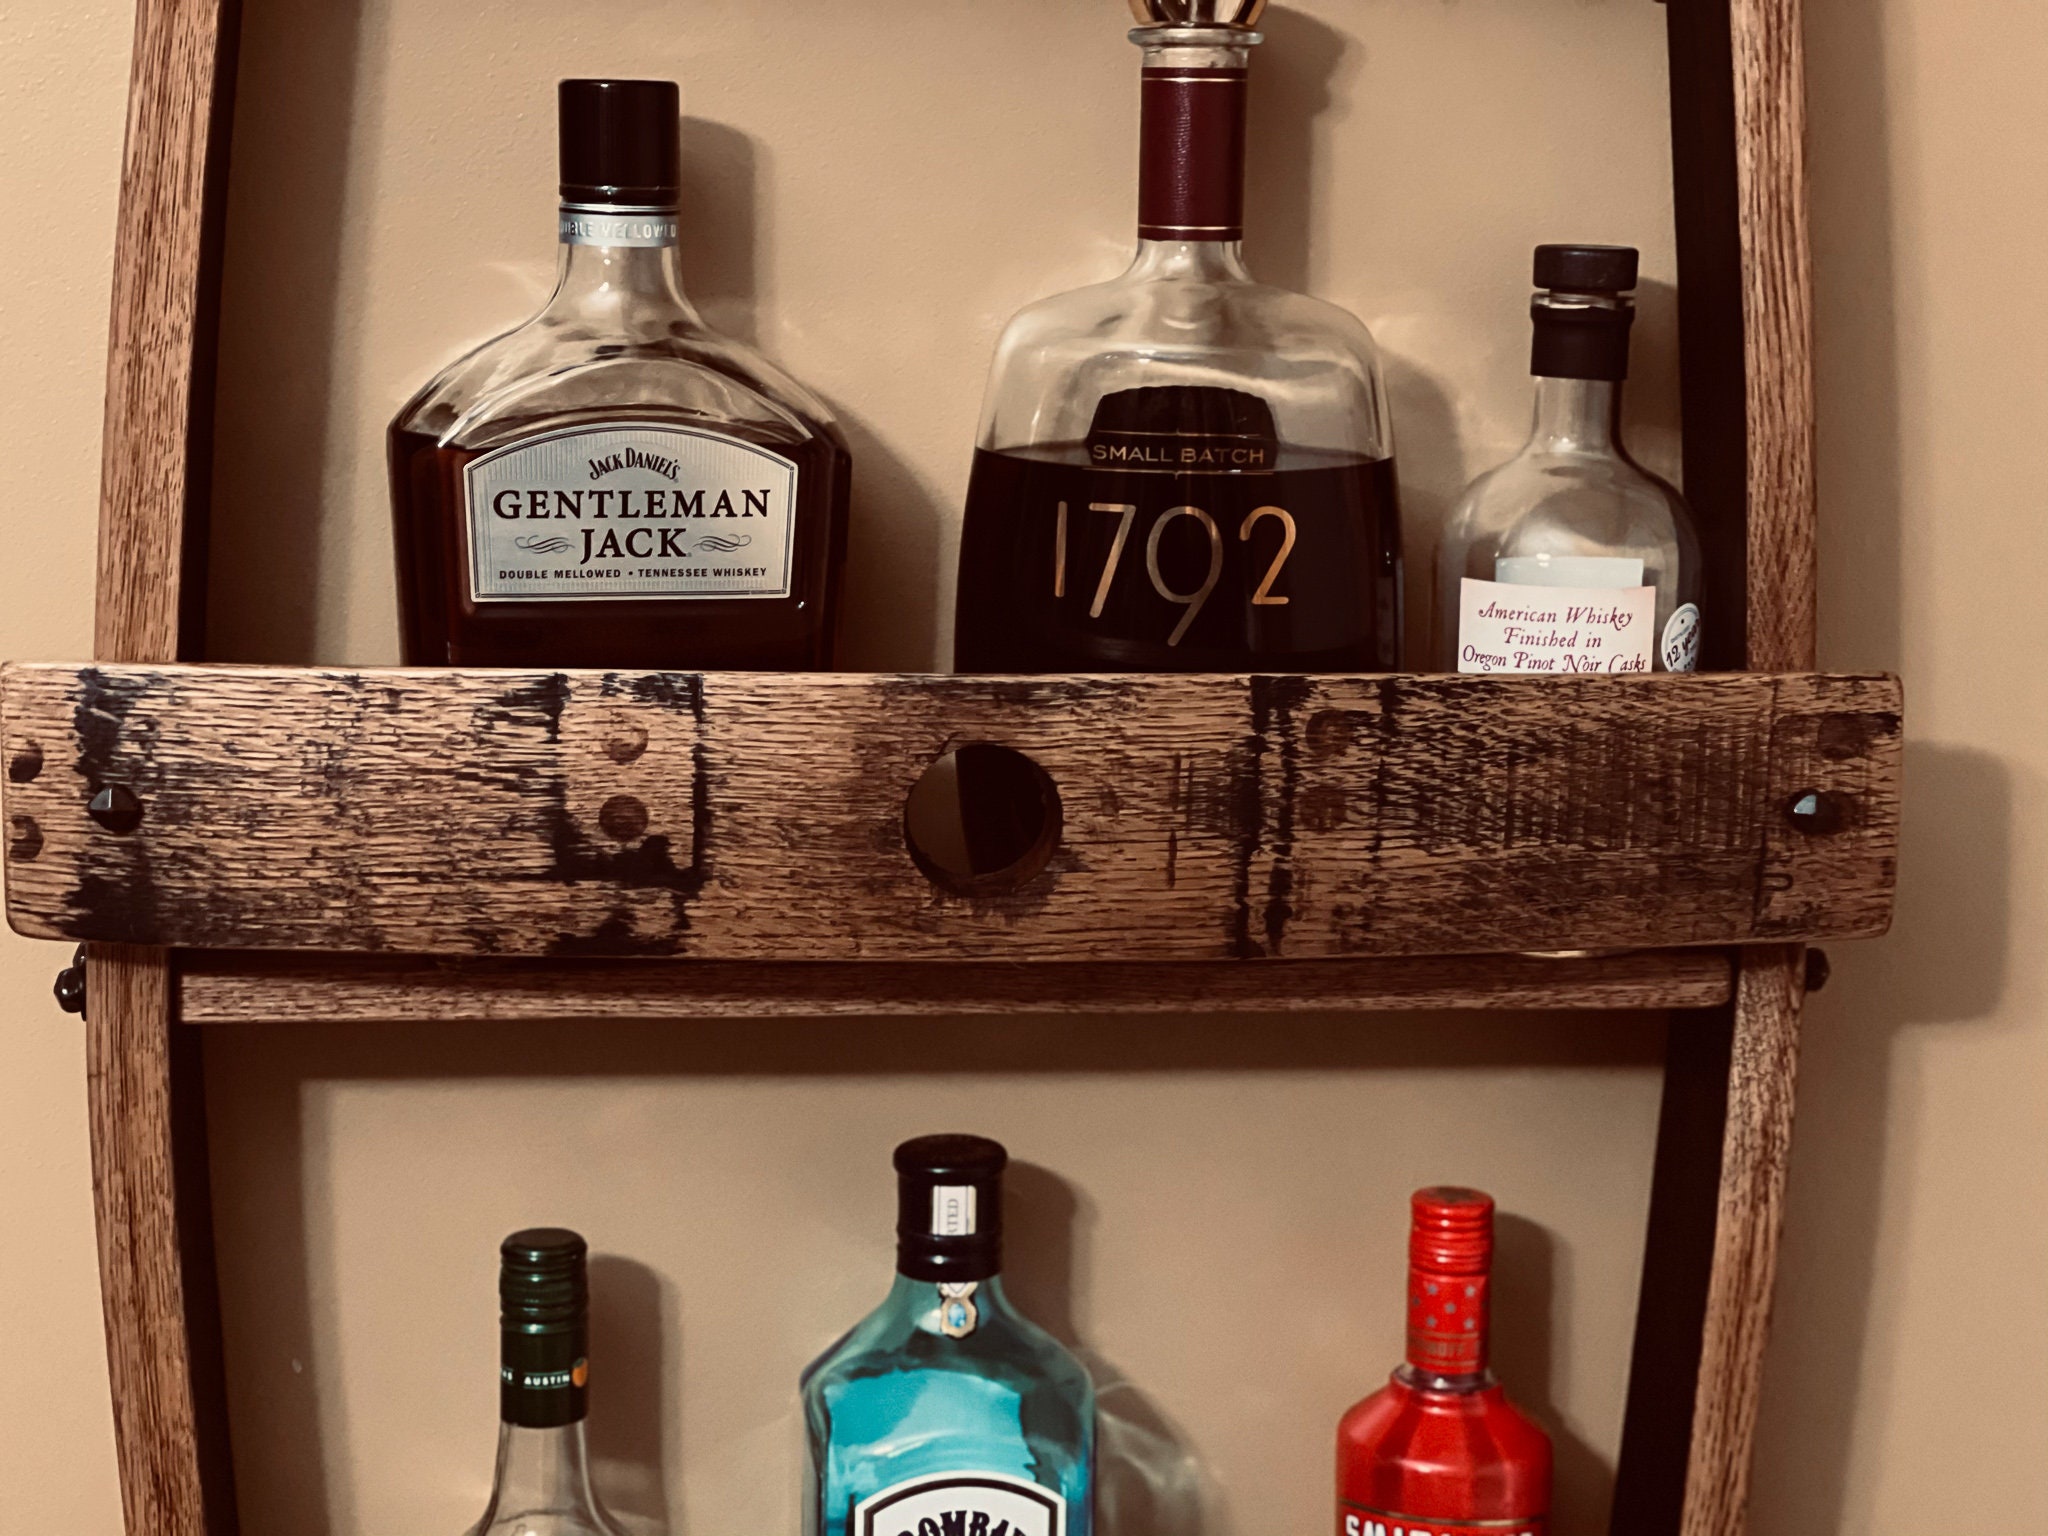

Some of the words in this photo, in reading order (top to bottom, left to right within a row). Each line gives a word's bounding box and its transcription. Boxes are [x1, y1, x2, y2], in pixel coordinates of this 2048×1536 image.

[1093, 444, 1173, 462] SMALL
[1180, 448, 1264, 464] BATCH
[492, 489, 771, 519] GENTLEMAN
[580, 528, 688, 565] JACK
[499, 569, 548, 580] DOUBLE
[554, 568, 621, 579] MELLOWED
[638, 567, 708, 578] TENNESSEE
[713, 567, 767, 578] WHISKEY
[1055, 501, 1296, 647] 1792
[1478, 601, 1557, 623] American
[1566, 606, 1633, 631] Whiskey
[1504, 626, 1578, 648] Finished
[1585, 632, 1602, 648] in
[1462, 645, 1507, 671] Oregon
[1513, 651, 1555, 671] Pinot
[1562, 654, 1602, 672] Noir
[1608, 653, 1646, 672] Casks
[1666, 645, 1681, 667] 12
[524, 1375, 570, 1386] AUSTIN
